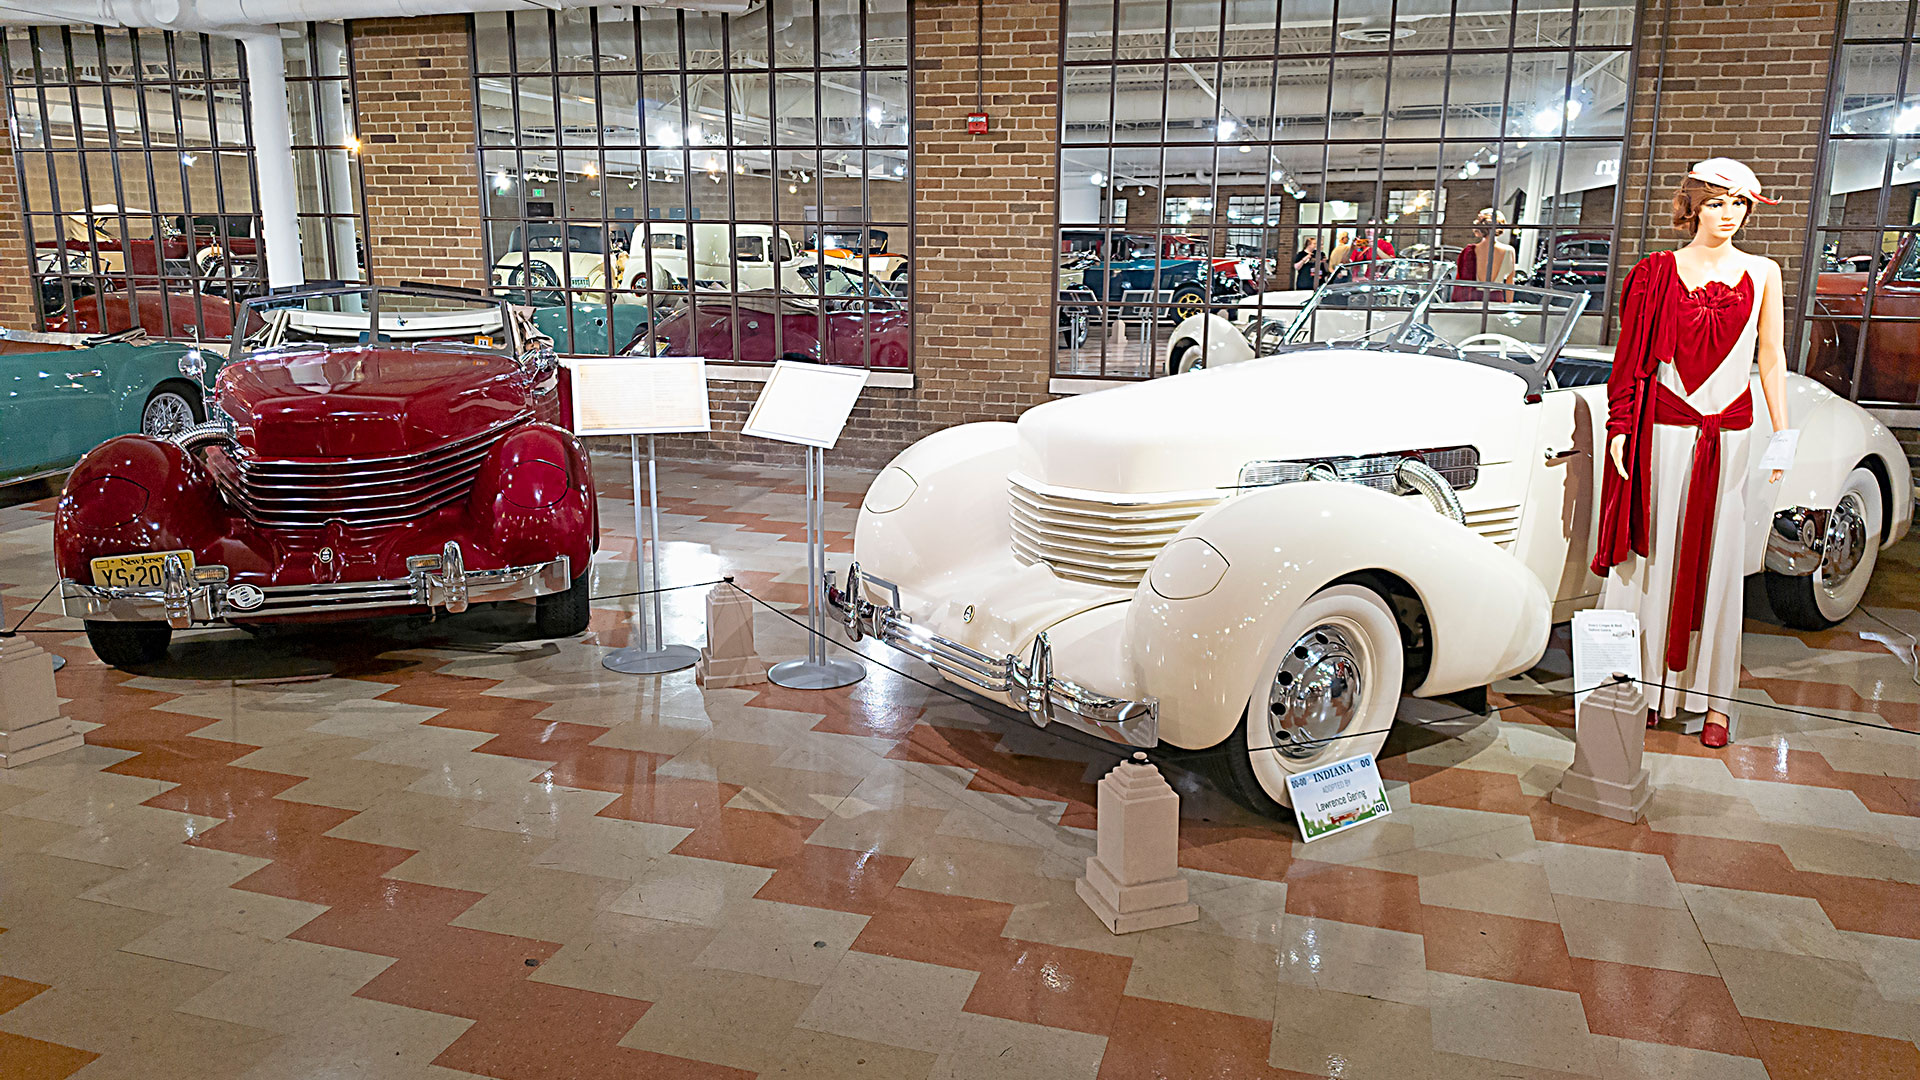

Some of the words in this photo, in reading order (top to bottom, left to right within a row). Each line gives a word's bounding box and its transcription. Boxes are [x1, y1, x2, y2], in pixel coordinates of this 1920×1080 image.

[121, 558, 141, 567] New
[1313, 763, 1353, 782] INDIANA
[1360, 758, 1370, 768] 00
[1322, 780, 1345, 793] ADOPTED
[1344, 779, 1351, 787] BY
[1316, 796, 1346, 812] Lawrence
[1347, 790, 1367, 802] Gering
[1375, 803, 1385, 812] 00
